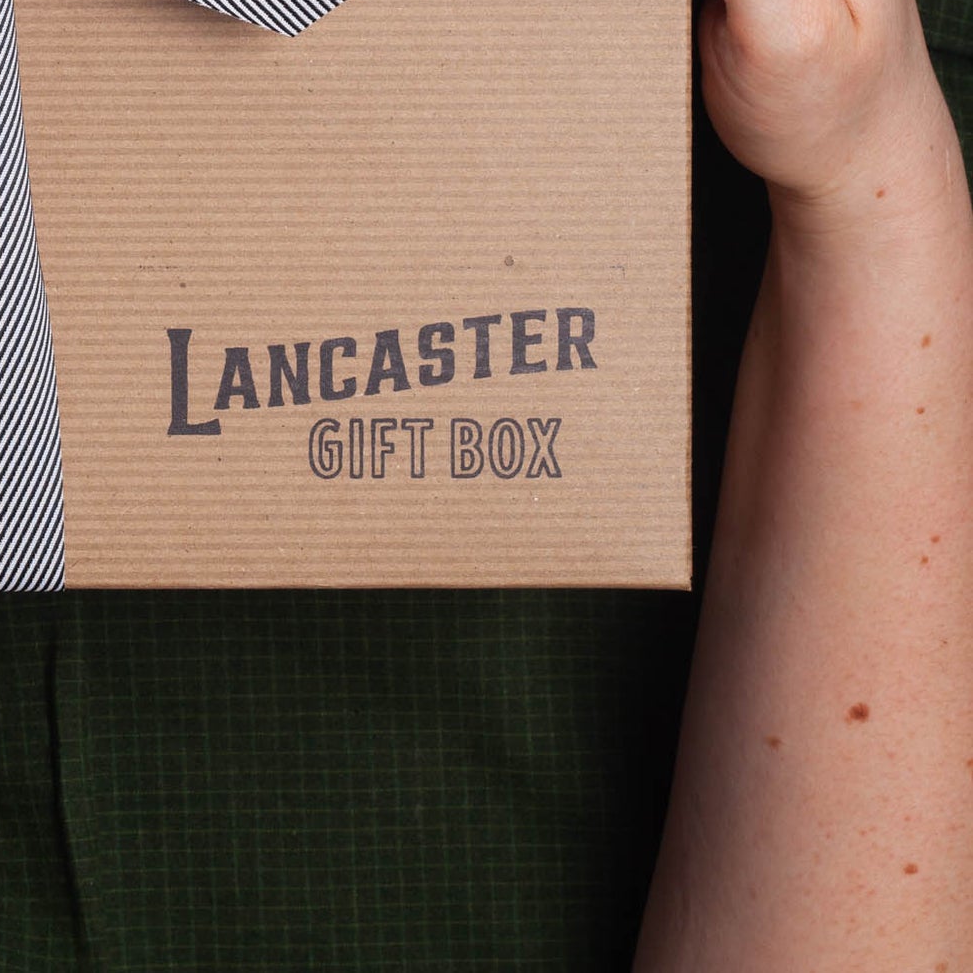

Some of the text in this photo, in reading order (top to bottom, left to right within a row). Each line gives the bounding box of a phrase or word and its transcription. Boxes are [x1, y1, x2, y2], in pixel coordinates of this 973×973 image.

[166, 307, 598, 436] LANCASTER
[308, 418, 563, 480] GIFT BOX
